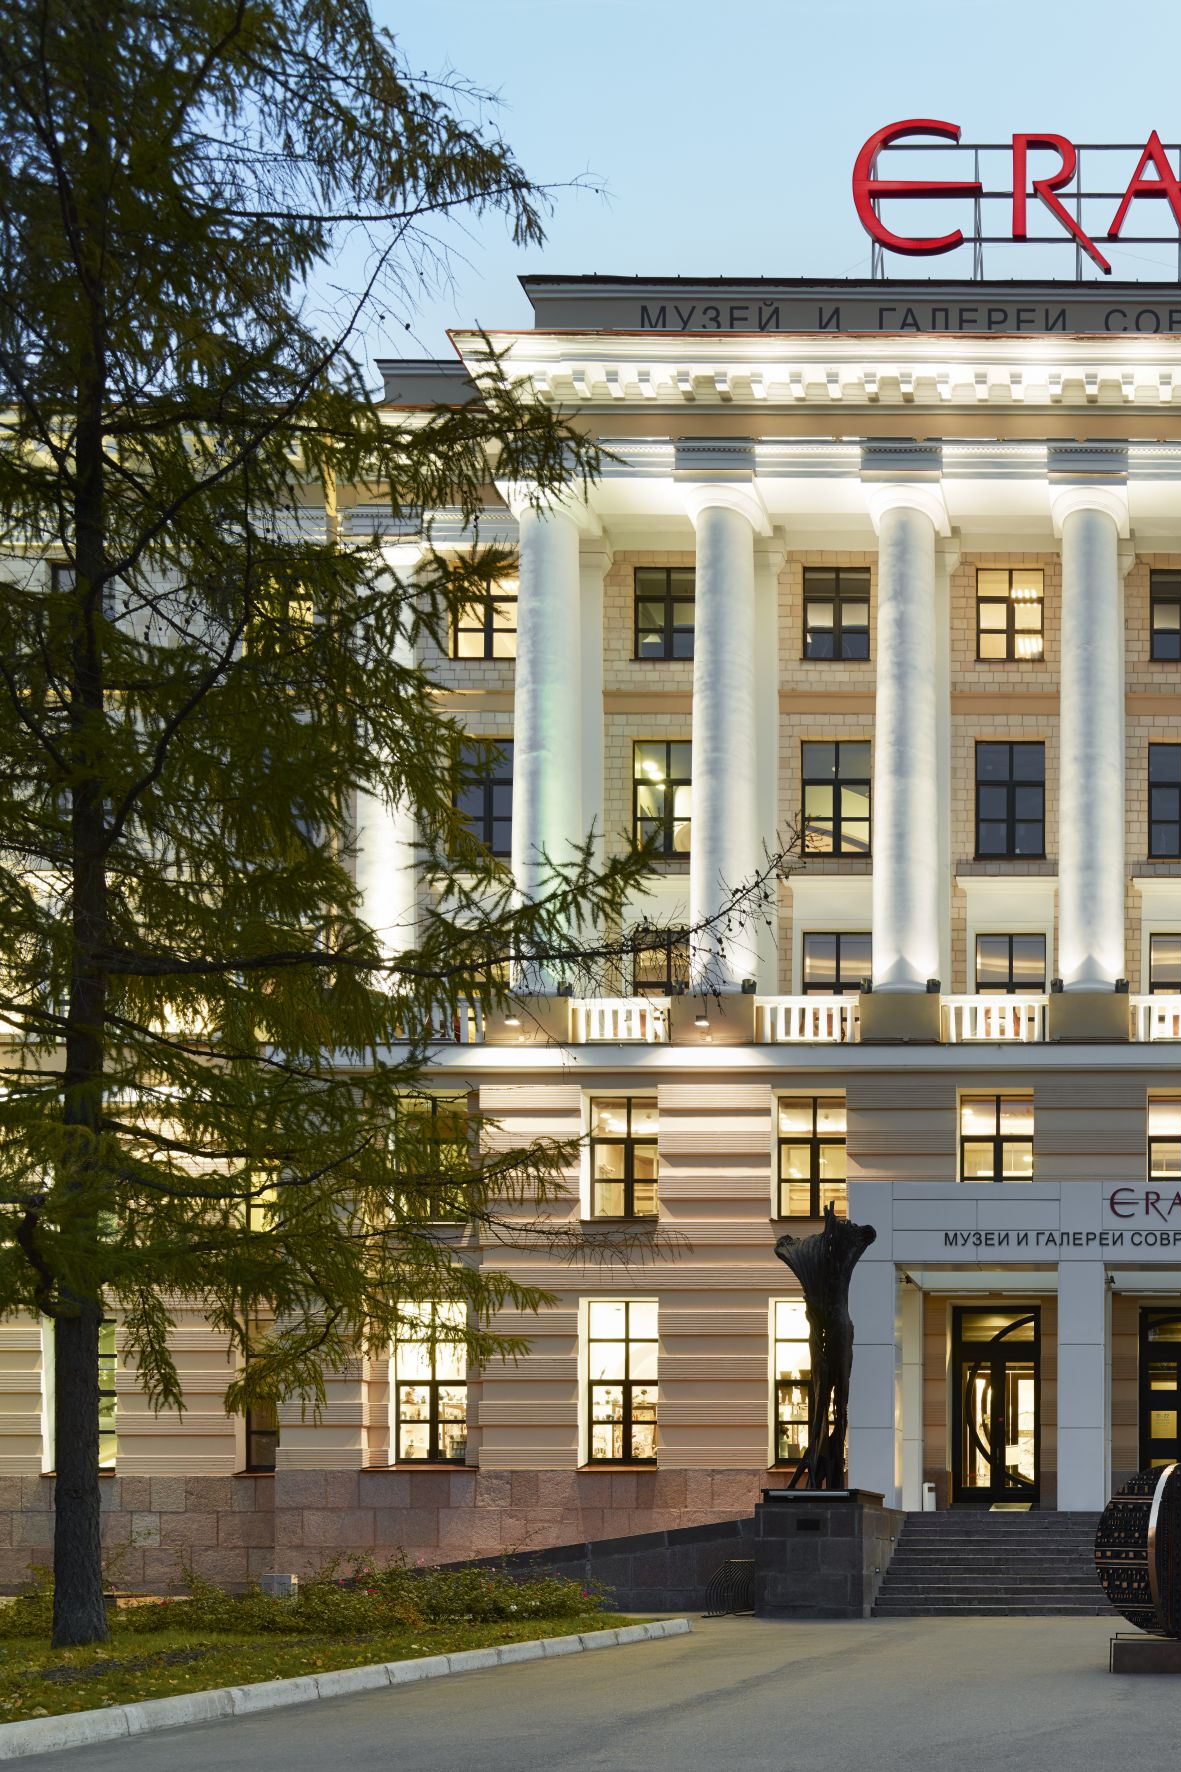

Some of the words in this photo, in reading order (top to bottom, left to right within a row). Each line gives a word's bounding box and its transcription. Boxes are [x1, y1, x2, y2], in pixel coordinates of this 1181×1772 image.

[640, 301, 780, 332] МУЗЕЙ
[818, 306, 841, 331] И
[878, 307, 1067, 332] ГАЛЕРЕИ
[944, 1232, 1010, 1247] МУЗЕИ
[1016, 1232, 1029, 1247] И
[1035, 1232, 1125, 1248] ГАЛЕРЕИ
